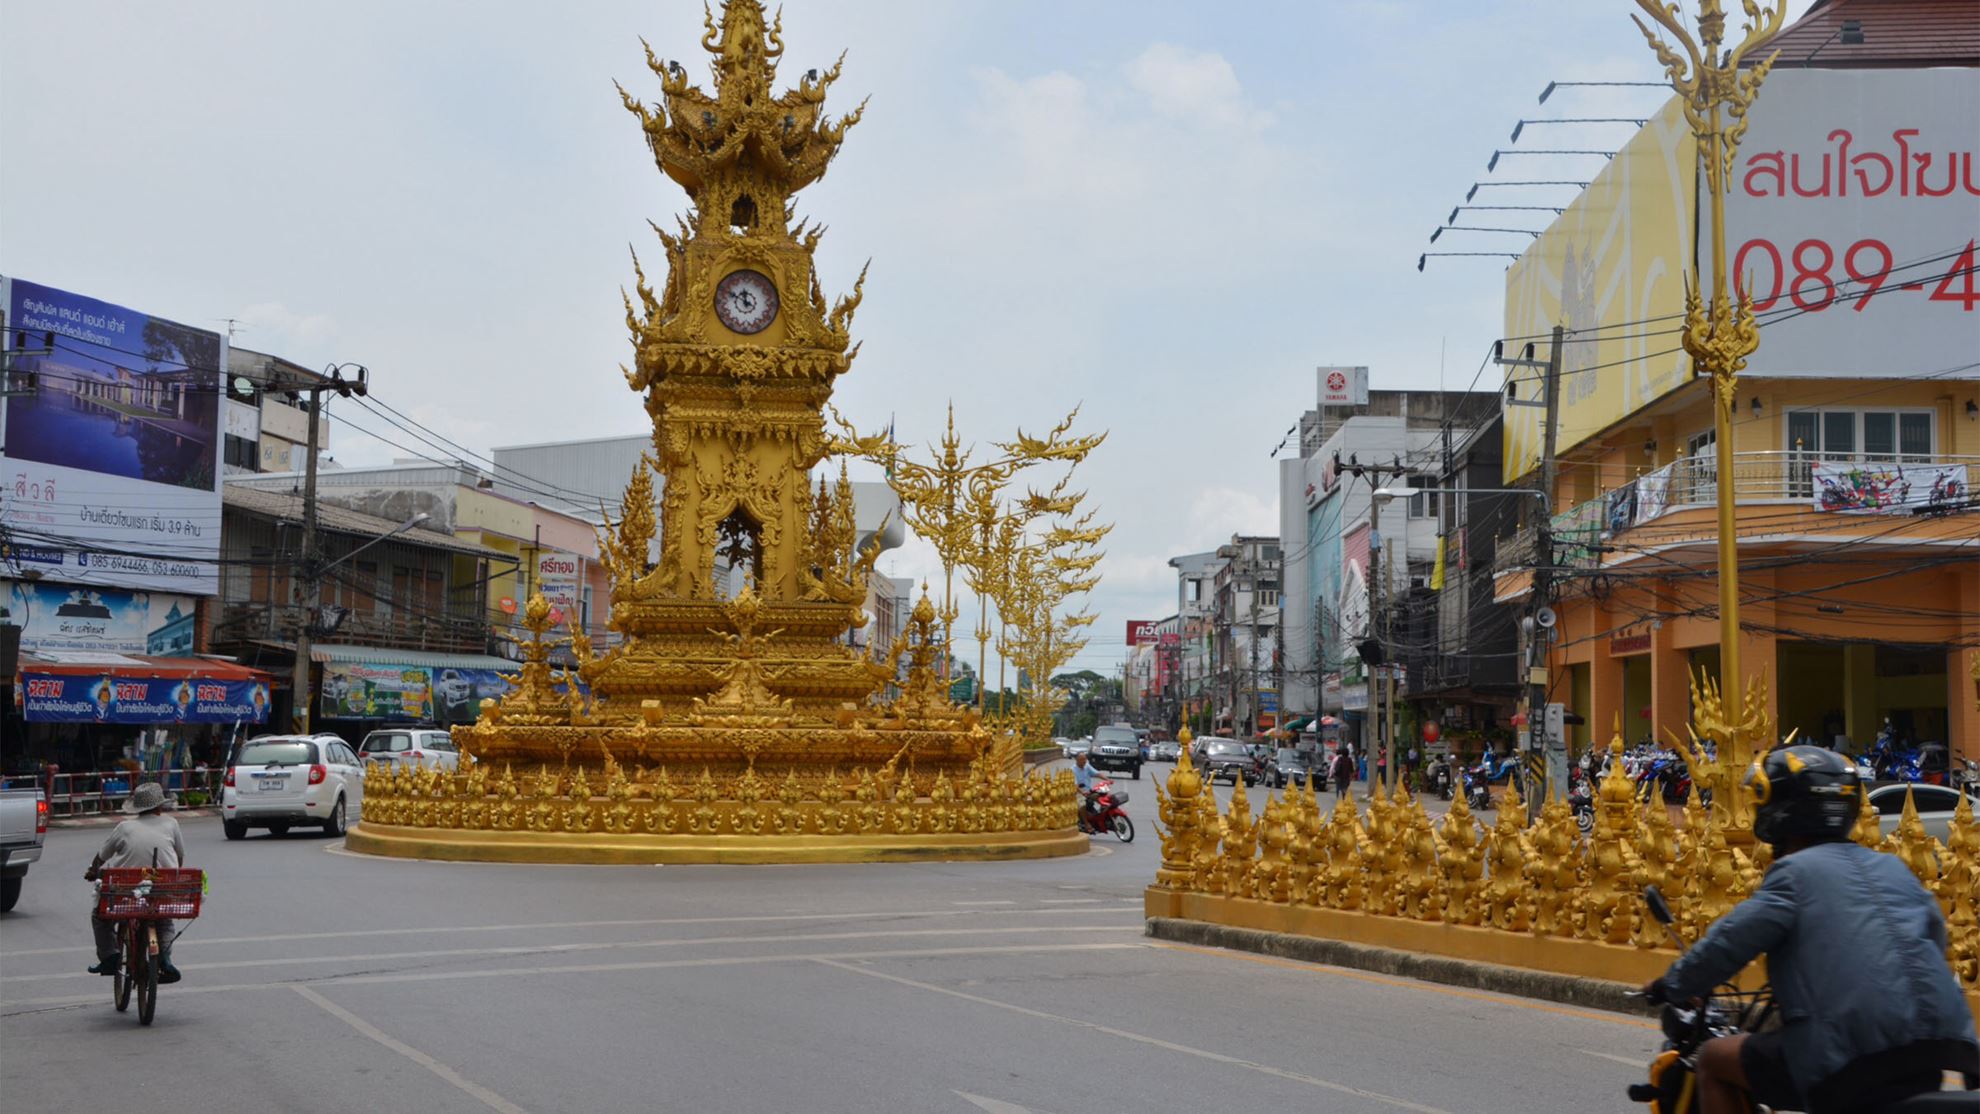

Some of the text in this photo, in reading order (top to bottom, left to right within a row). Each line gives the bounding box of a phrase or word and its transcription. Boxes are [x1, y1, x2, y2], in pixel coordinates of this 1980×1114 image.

[1732, 238, 1980, 313] 089-4
[540, 557, 575, 573] ศรีทอง
